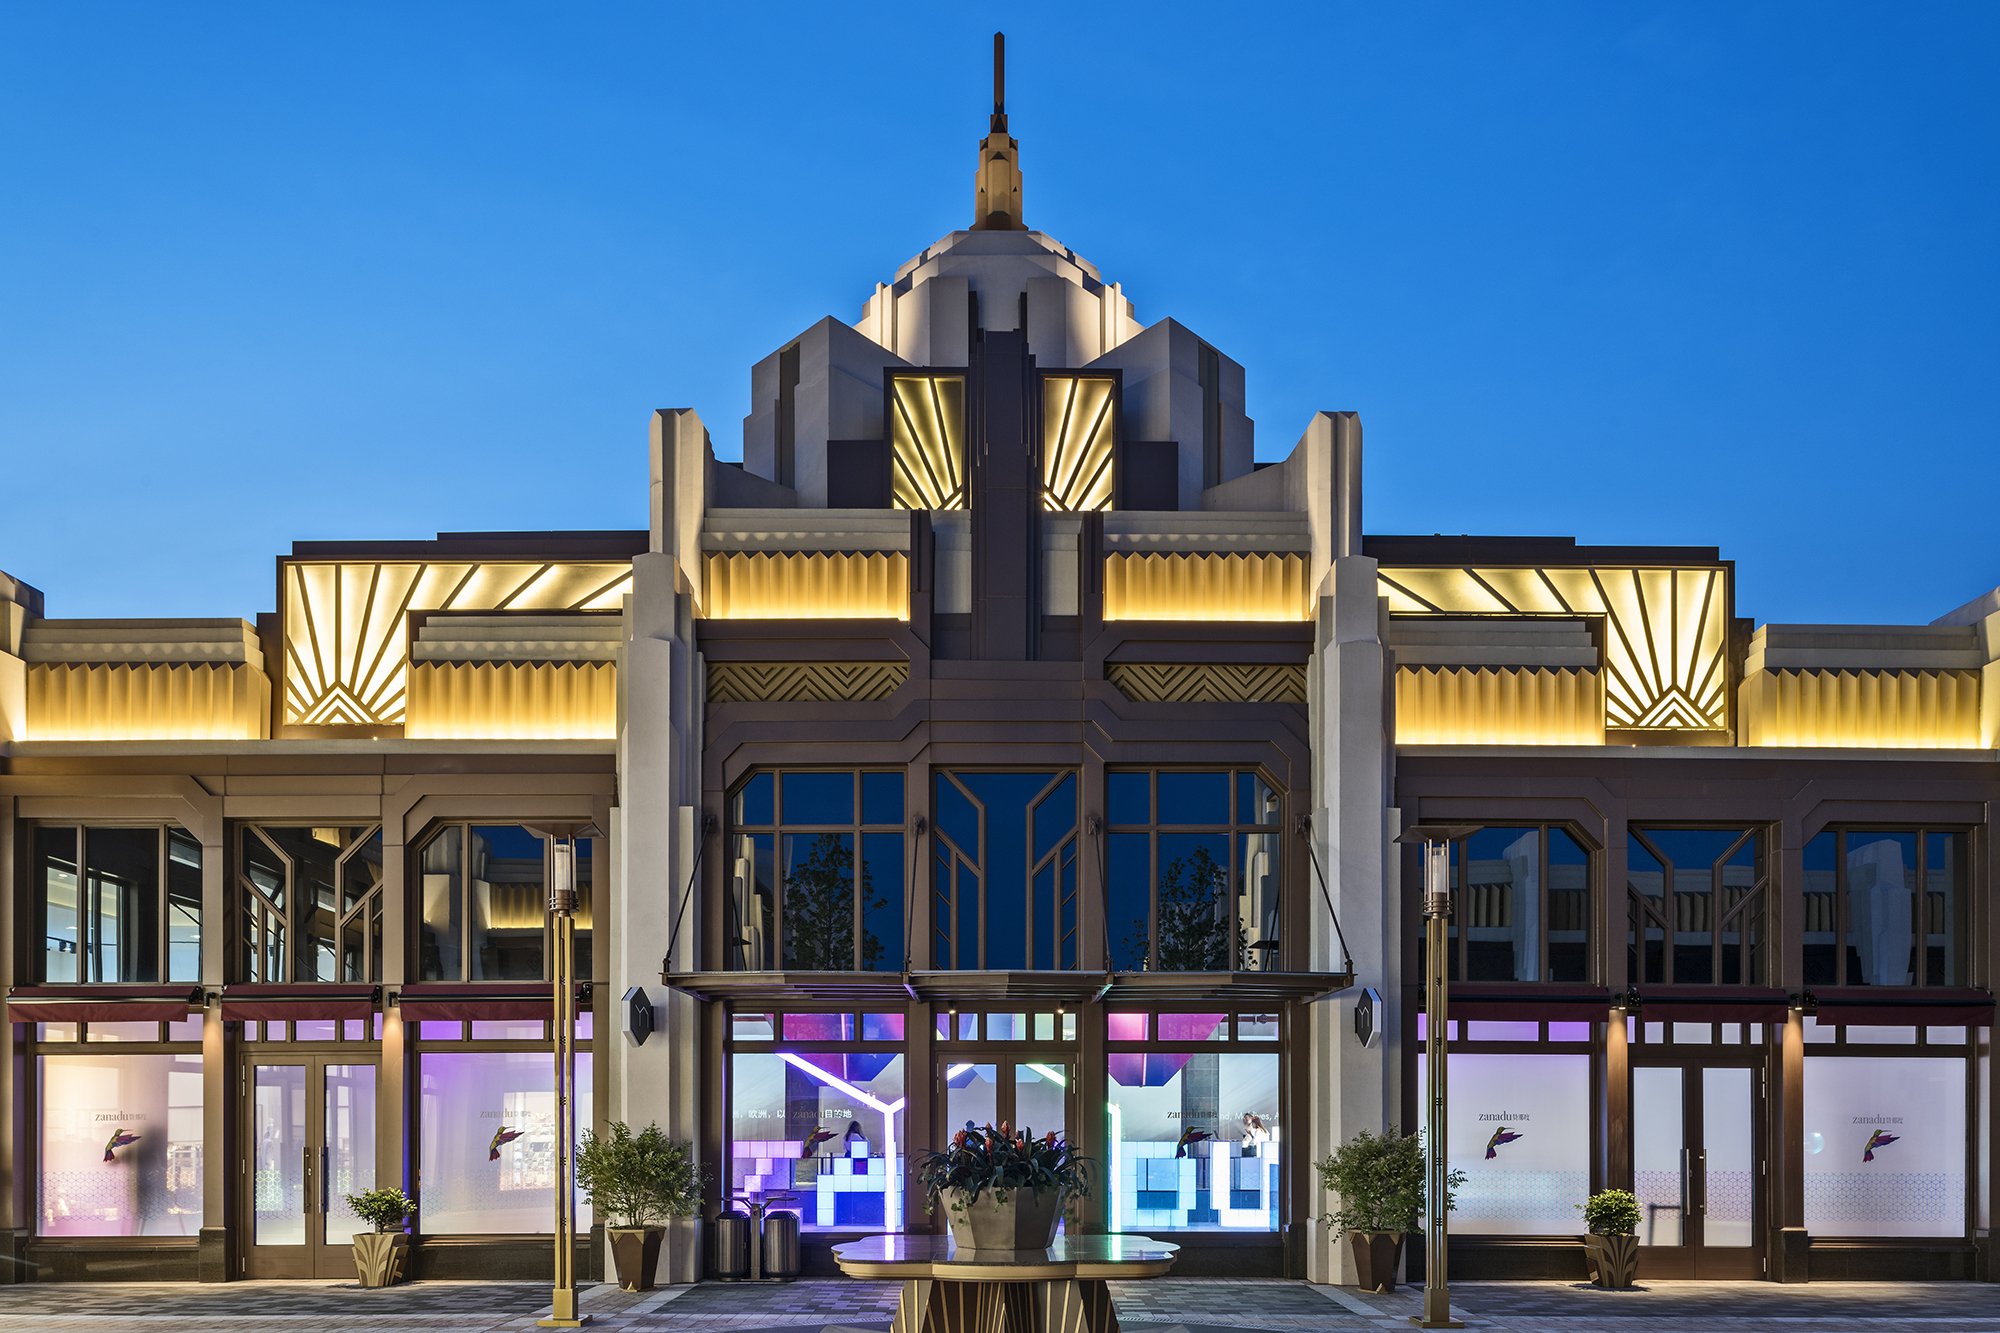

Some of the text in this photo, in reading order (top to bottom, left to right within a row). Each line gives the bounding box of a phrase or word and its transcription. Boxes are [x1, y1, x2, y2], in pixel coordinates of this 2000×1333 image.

[95, 1110, 128, 1121] zanadu
[479, 1107, 513, 1118] zanadu
[825, 1108, 853, 1119] 目的地
[1167, 1108, 1200, 1119] zanadu
[1478, 1110, 1512, 1121] zanadu
[1852, 1113, 1886, 1124] zanadu
